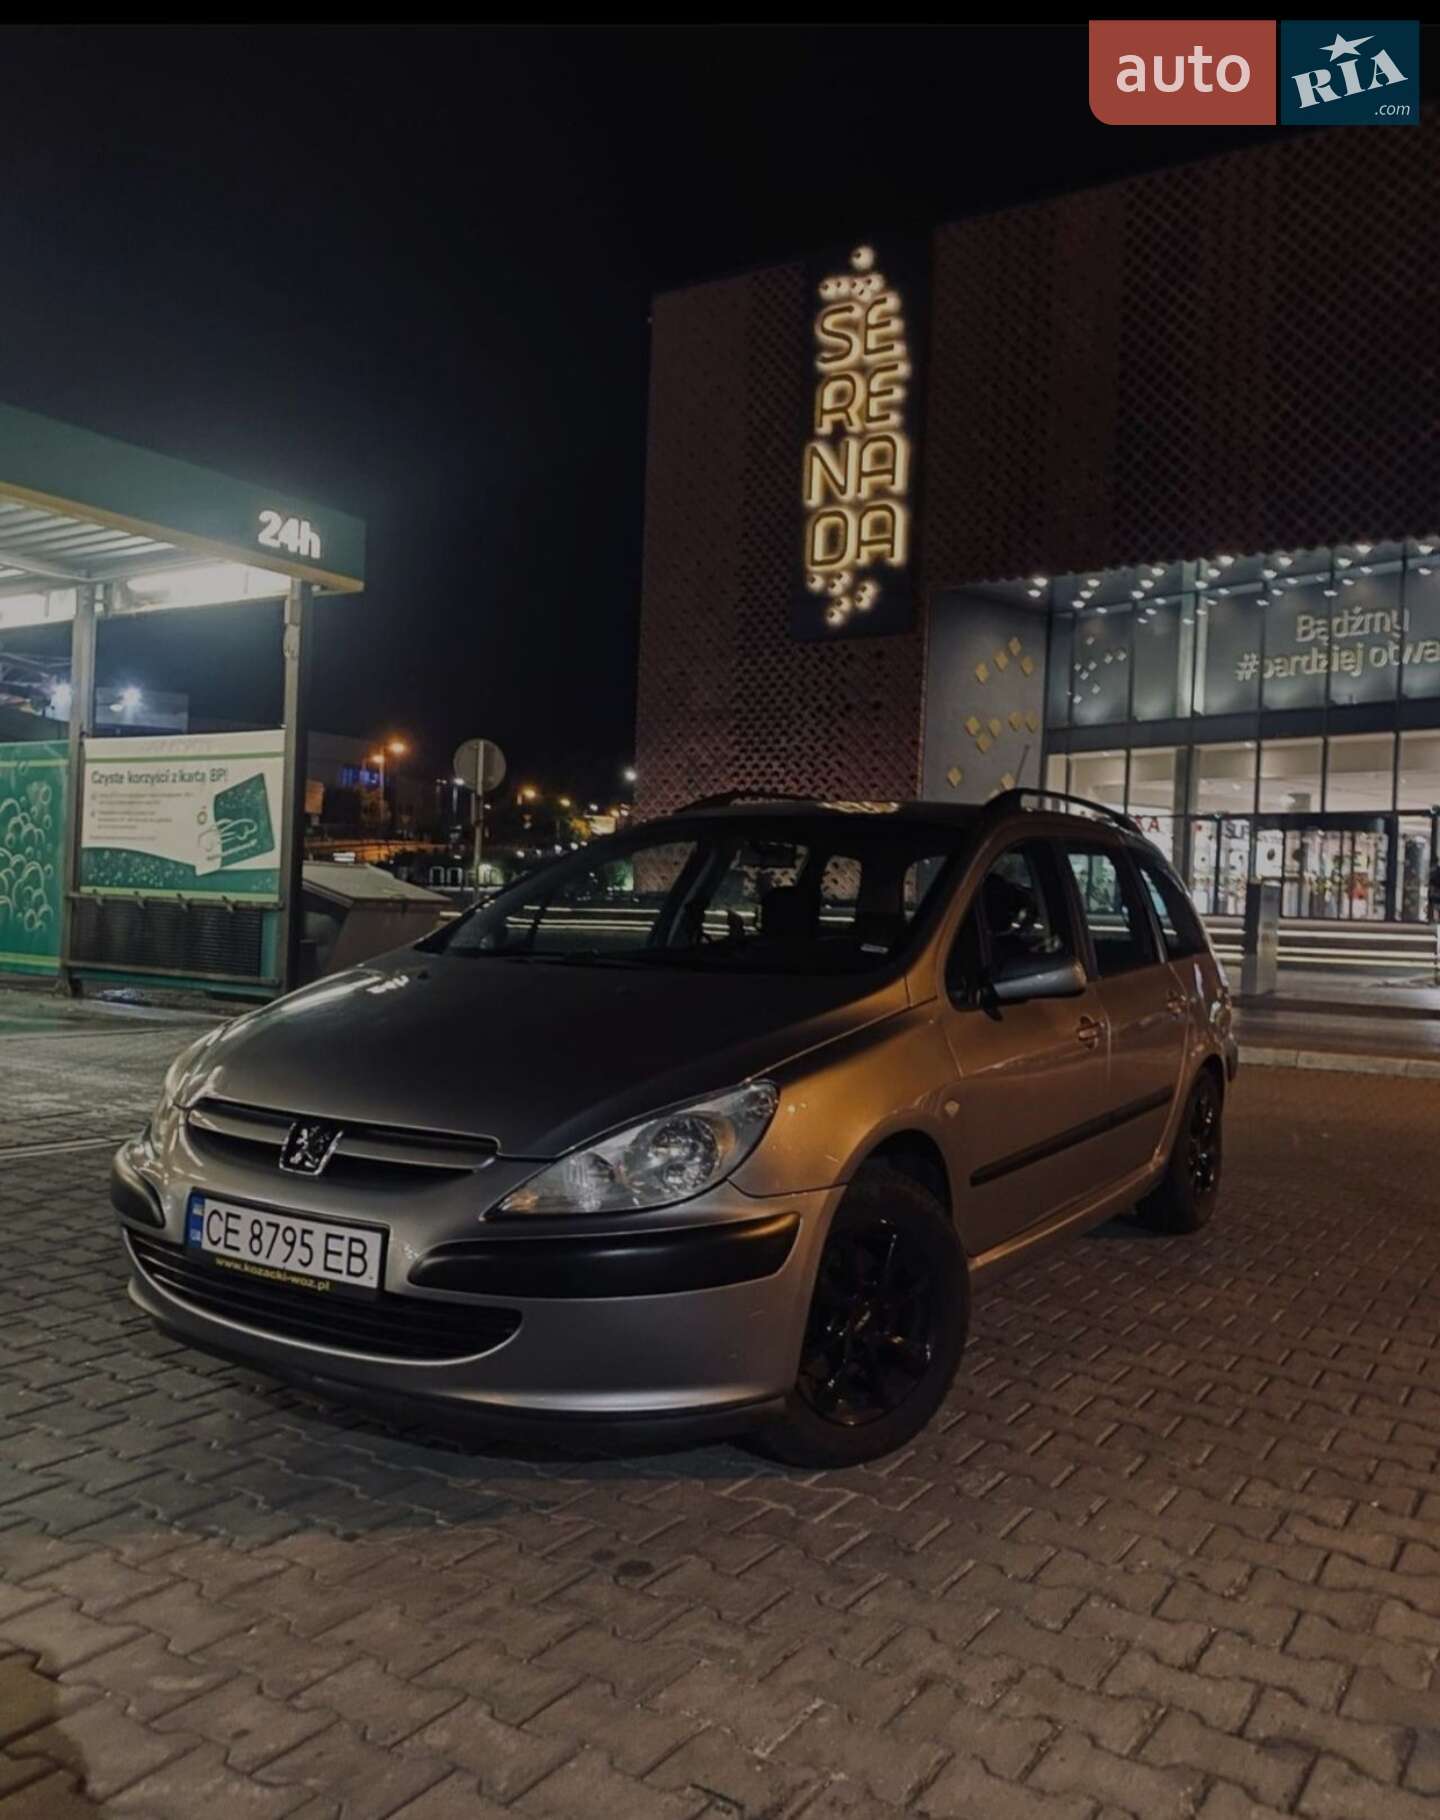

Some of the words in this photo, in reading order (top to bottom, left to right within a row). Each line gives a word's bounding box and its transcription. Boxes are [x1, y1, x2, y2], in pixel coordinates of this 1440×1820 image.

[258, 510, 320, 558] 24h
[1296, 606, 1410, 645] Bądźmy
[91, 770, 124, 785] Czyste
[172, 772, 178, 783] z
[206, 1210, 242, 1251] CE
[249, 1219, 314, 1268] 8795
[323, 1233, 368, 1278] EB
